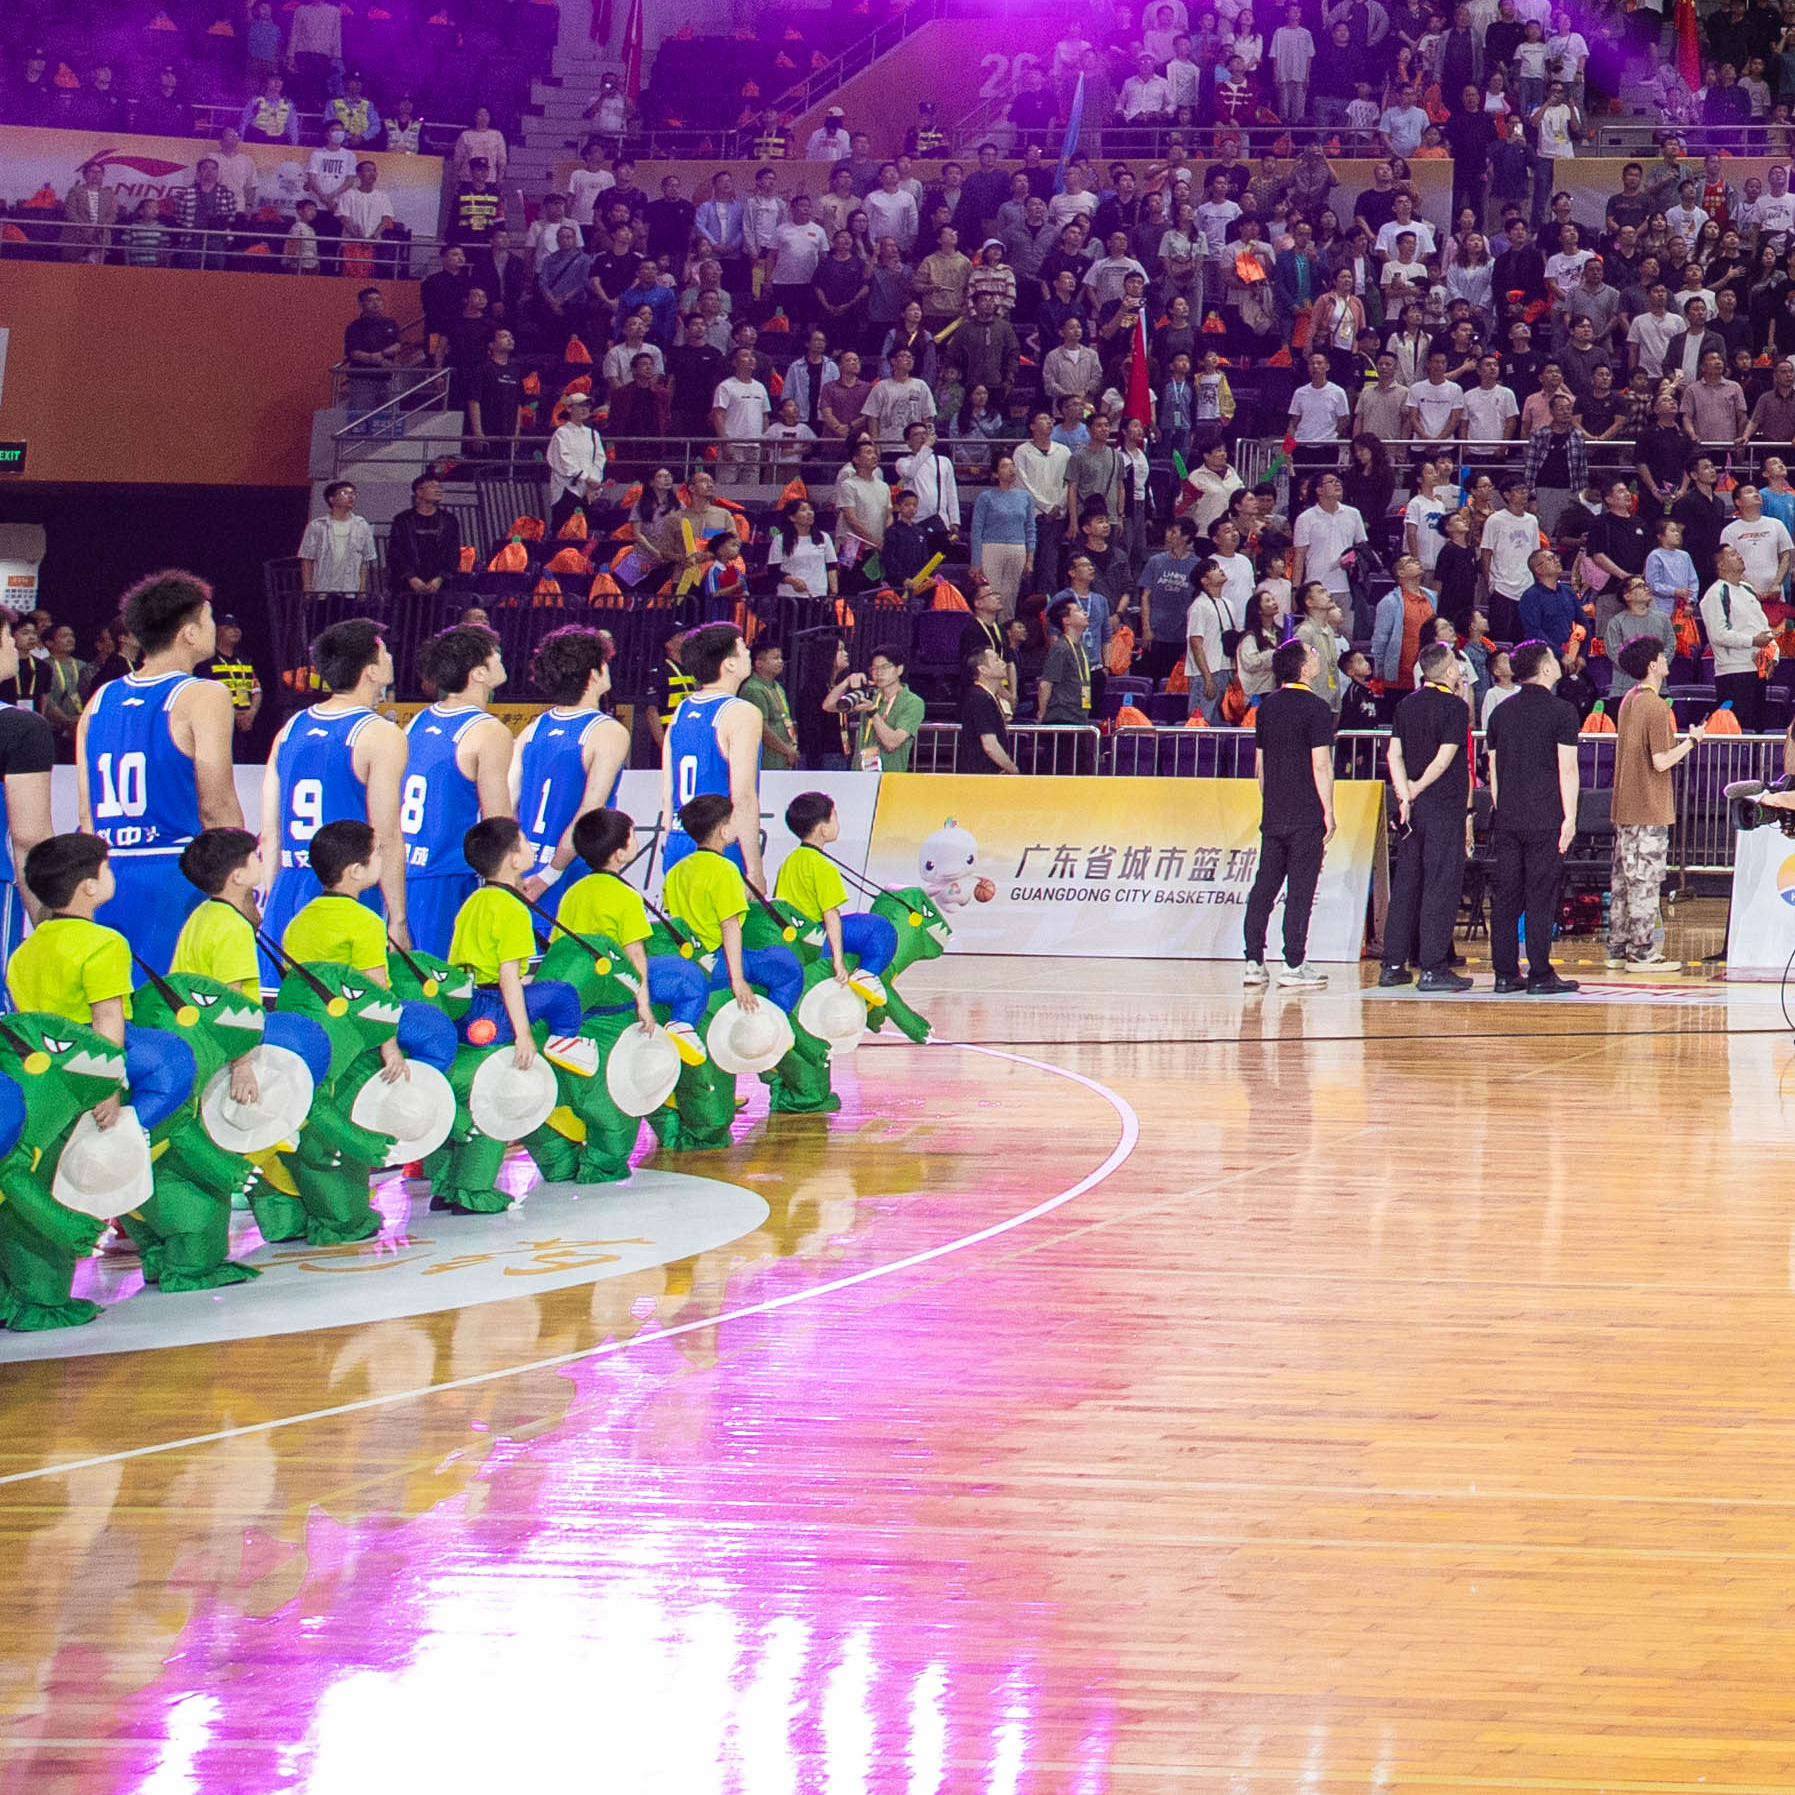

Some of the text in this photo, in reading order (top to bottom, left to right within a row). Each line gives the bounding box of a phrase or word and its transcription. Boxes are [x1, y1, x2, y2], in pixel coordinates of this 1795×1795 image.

[0, 450, 21, 461] EXIT
[97, 752, 147, 817] 10
[400, 774, 428, 834] 8
[532, 778, 552, 834] 1
[680, 755, 698, 806] 0
[290, 779, 324, 840] 9
[1013, 843, 1259, 883] 广东省城市篮球
[1010, 887, 1249, 905] GUANGDONG CITY BASKETBAL
